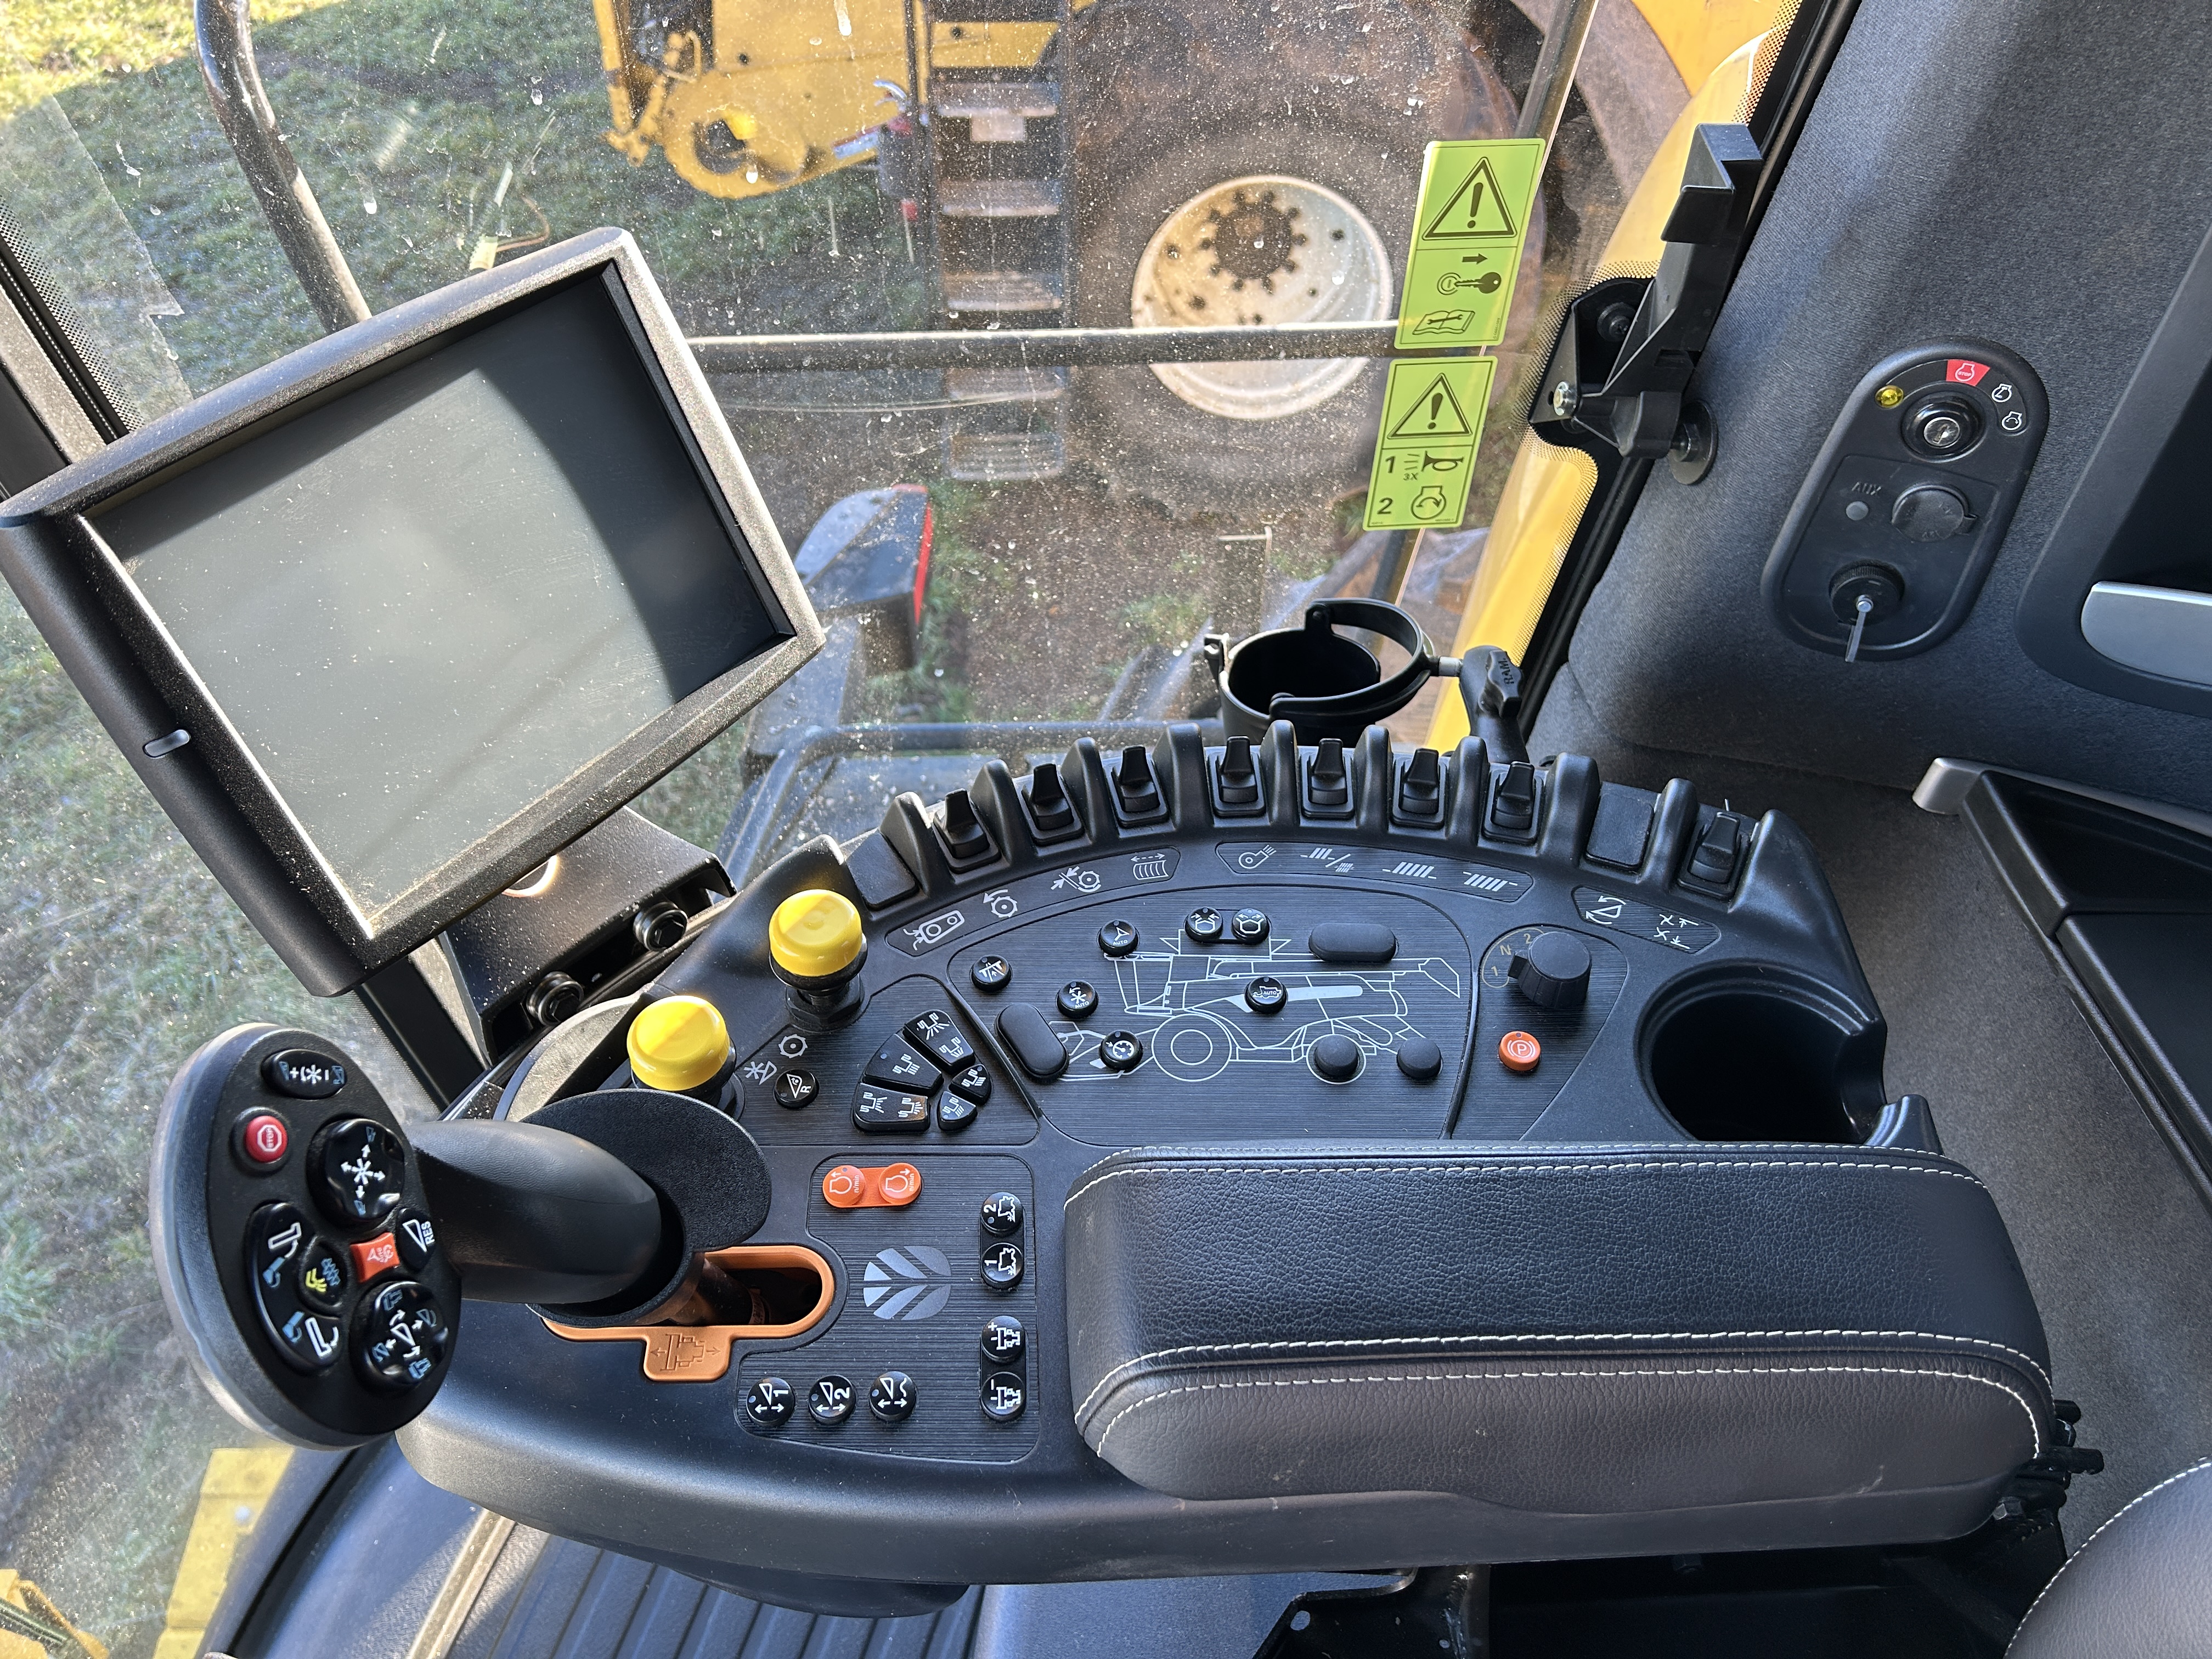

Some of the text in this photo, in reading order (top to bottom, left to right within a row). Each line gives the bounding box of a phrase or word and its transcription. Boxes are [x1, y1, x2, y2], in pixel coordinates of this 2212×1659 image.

[1385, 455, 1396, 473] 1
[1377, 497, 1393, 515] 2
[1523, 933, 1533, 944] 2
[1499, 945, 1512, 956] N
[1491, 966, 1498, 977] 1
[1517, 1043, 1527, 1054] P
[983, 1203, 996, 1213] 2
[421, 1221, 435, 1245] RES
[834, 1387, 850, 1400] 2
